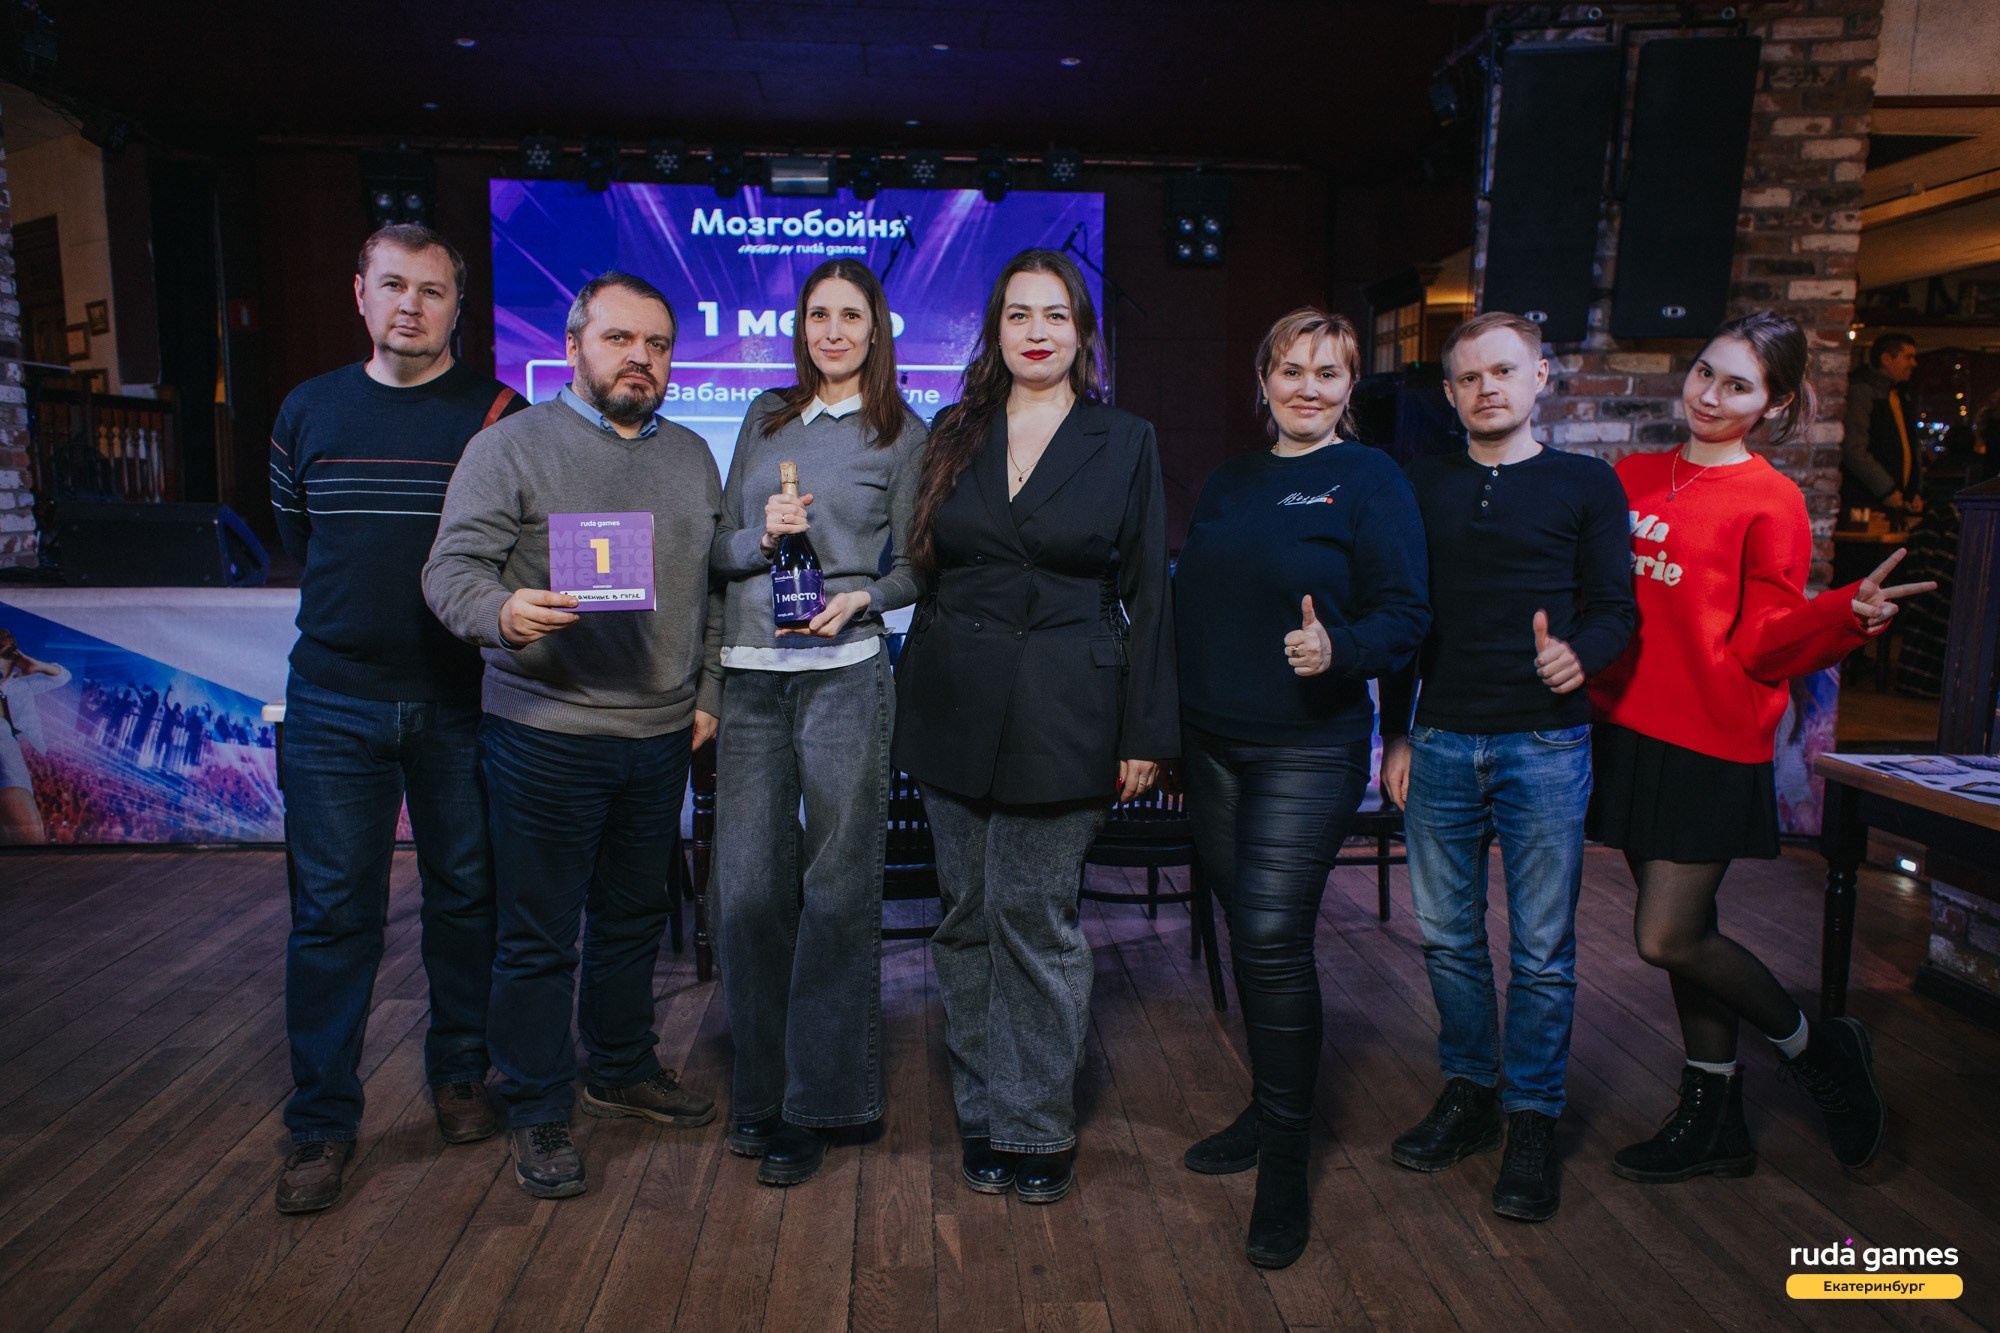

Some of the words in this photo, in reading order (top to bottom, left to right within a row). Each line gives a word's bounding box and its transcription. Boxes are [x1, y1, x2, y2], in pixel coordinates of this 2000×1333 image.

[691, 208, 906, 239] Мозгобойня
[826, 245, 867, 257] games
[698, 301, 719, 337] 1
[664, 382, 762, 402] Забане
[597, 520, 621, 528] games
[590, 538, 610, 574] 1
[1630, 550, 1683, 587] rie
[776, 593, 780, 603] 1
[782, 592, 817, 602] место
